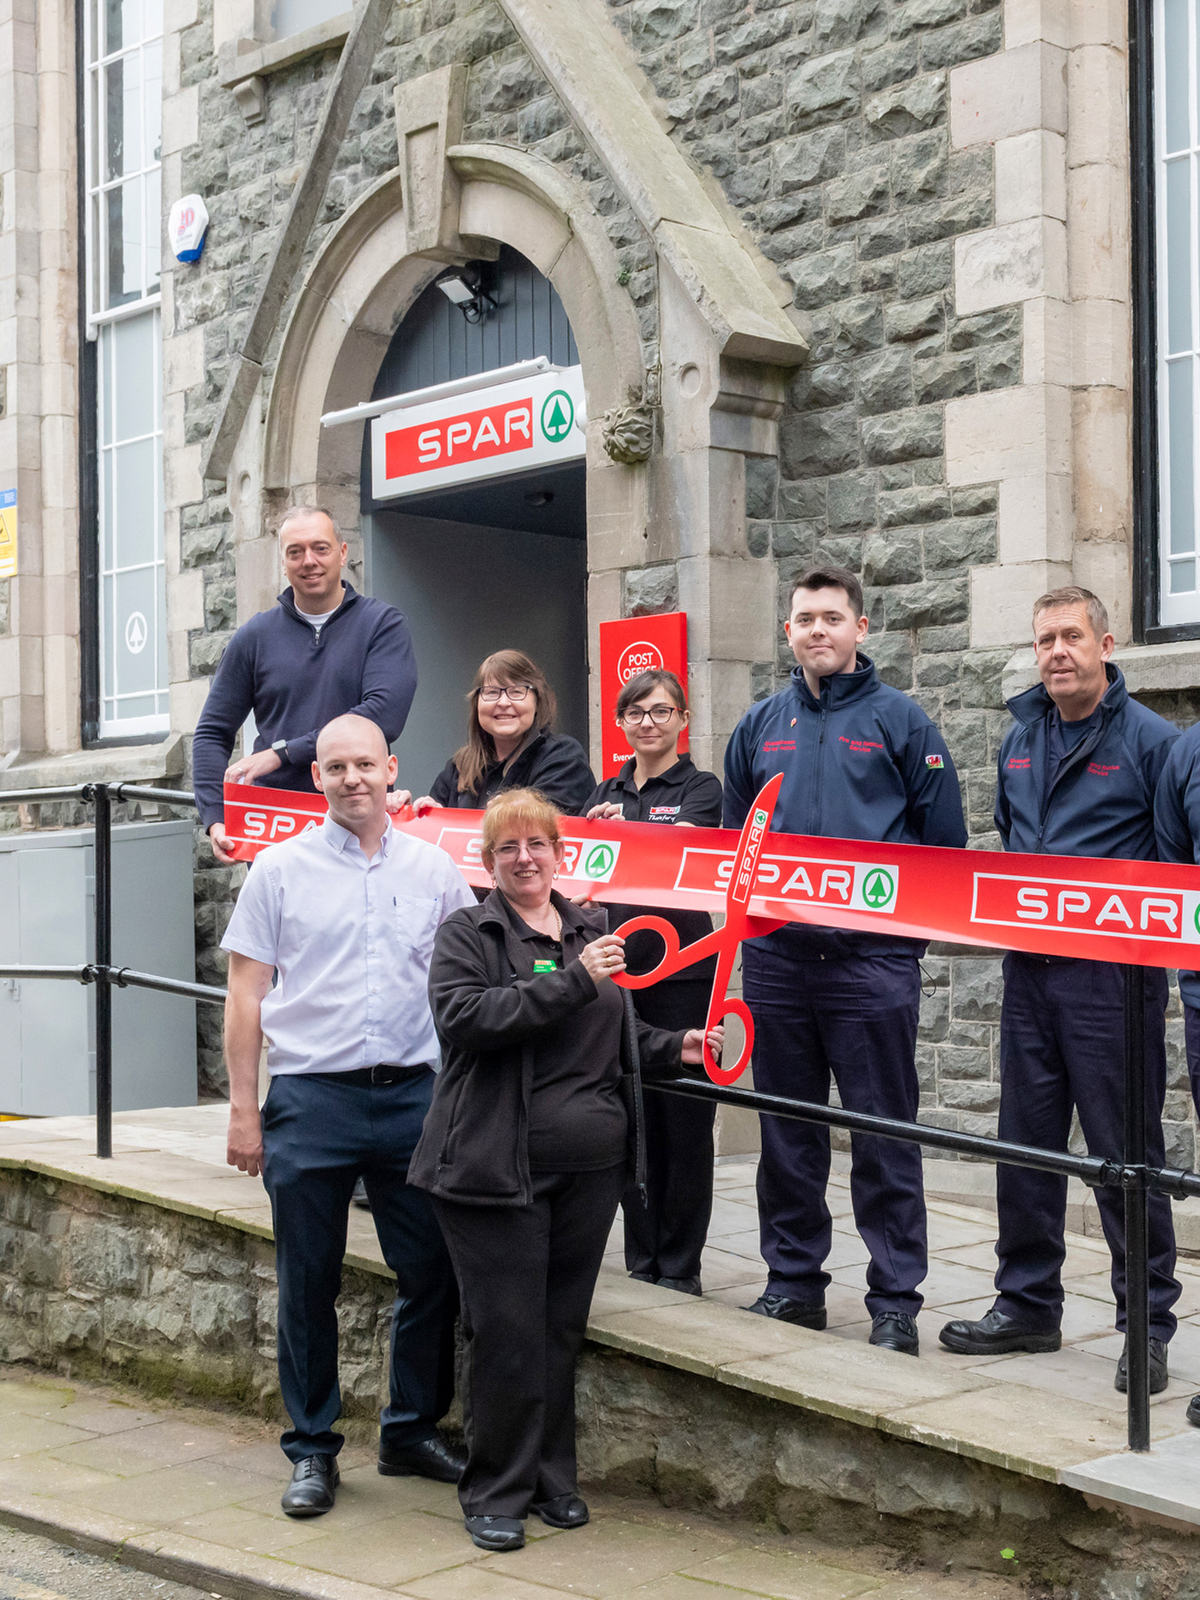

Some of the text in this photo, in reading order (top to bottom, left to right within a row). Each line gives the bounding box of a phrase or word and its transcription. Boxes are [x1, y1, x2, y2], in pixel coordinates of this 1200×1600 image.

[418, 407, 531, 464] SPAR
[628, 652, 654, 667] POST
[739, 827, 762, 886] SPAR
[1016, 887, 1179, 933] SPAR
